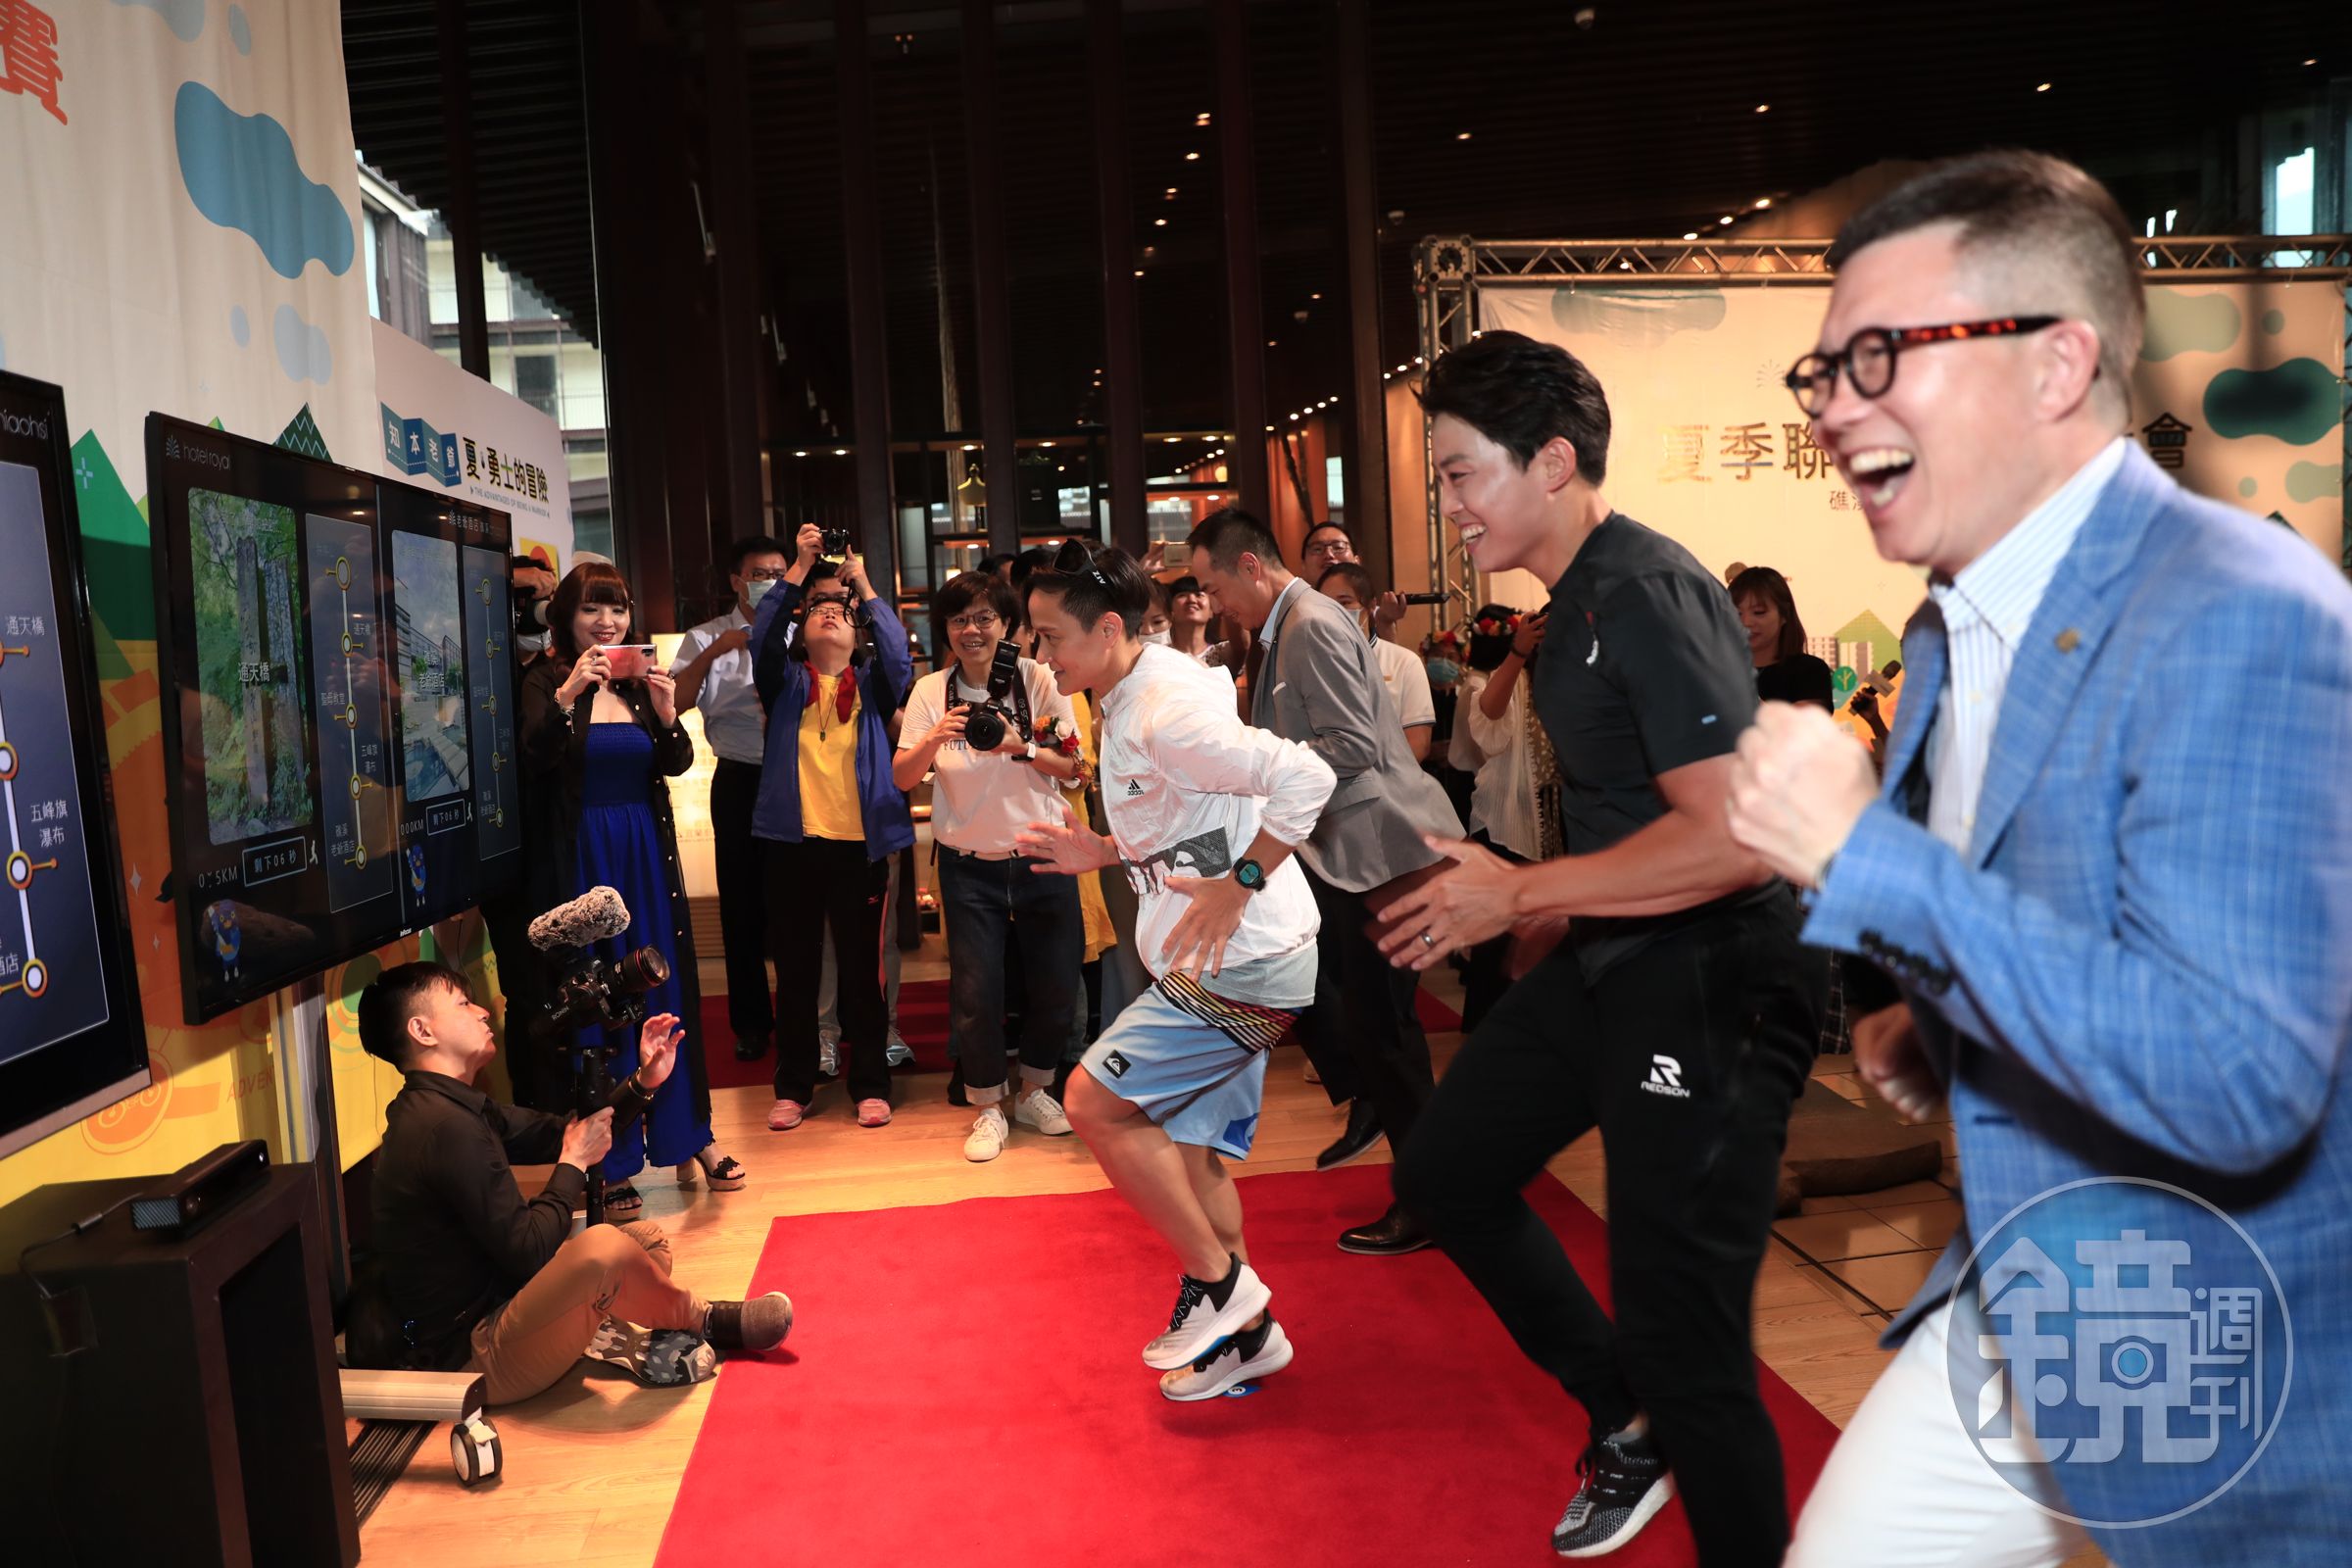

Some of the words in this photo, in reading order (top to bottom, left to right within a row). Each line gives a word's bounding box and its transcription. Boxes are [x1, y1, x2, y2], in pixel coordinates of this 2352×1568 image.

[2142, 412, 2192, 468] 會
[183, 444, 209, 464] hotel
[209, 452, 231, 470] royal
[6, 615, 45, 636] 通天橋
[238, 662, 270, 683] 通天橋
[30, 799, 69, 823] 五峰旗
[39, 826, 65, 848] 瀑布
